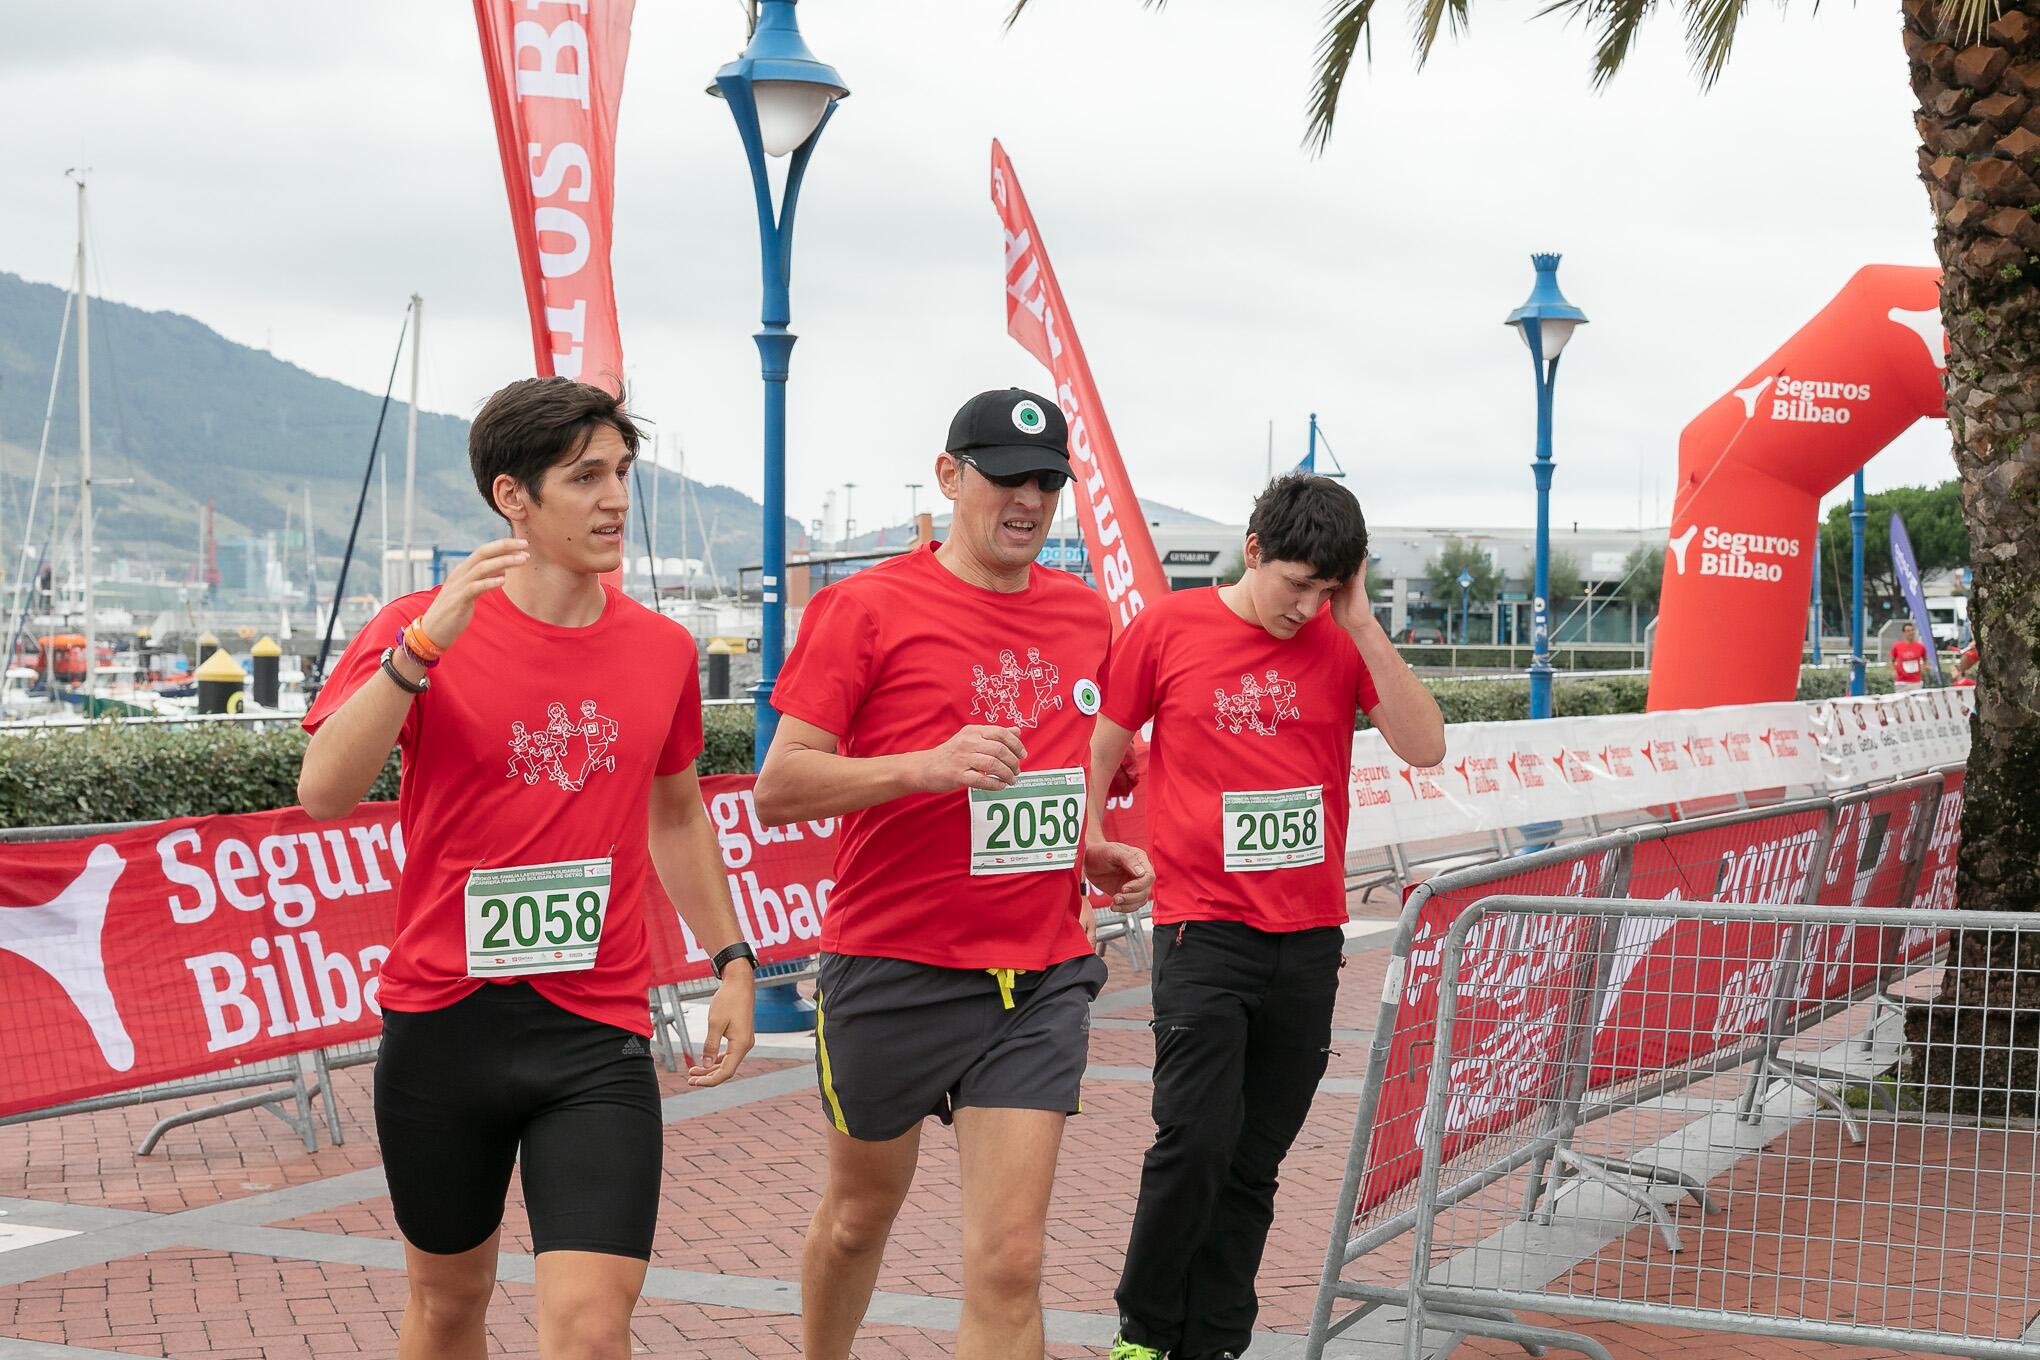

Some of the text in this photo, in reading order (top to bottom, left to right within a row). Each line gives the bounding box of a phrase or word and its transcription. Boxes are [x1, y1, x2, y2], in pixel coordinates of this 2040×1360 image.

[1775, 376, 1871, 401] Seguros
[1771, 399, 1850, 424] Bilbao
[1702, 526, 1800, 557] Seguros
[1700, 553, 1783, 582] Bilbao
[1350, 765, 1391, 785] Seguros
[1356, 786, 1391, 807] Bilbao
[986, 797, 1080, 850] 2058
[1236, 809, 1317, 851] 2058
[481, 890, 602, 949] 2058
